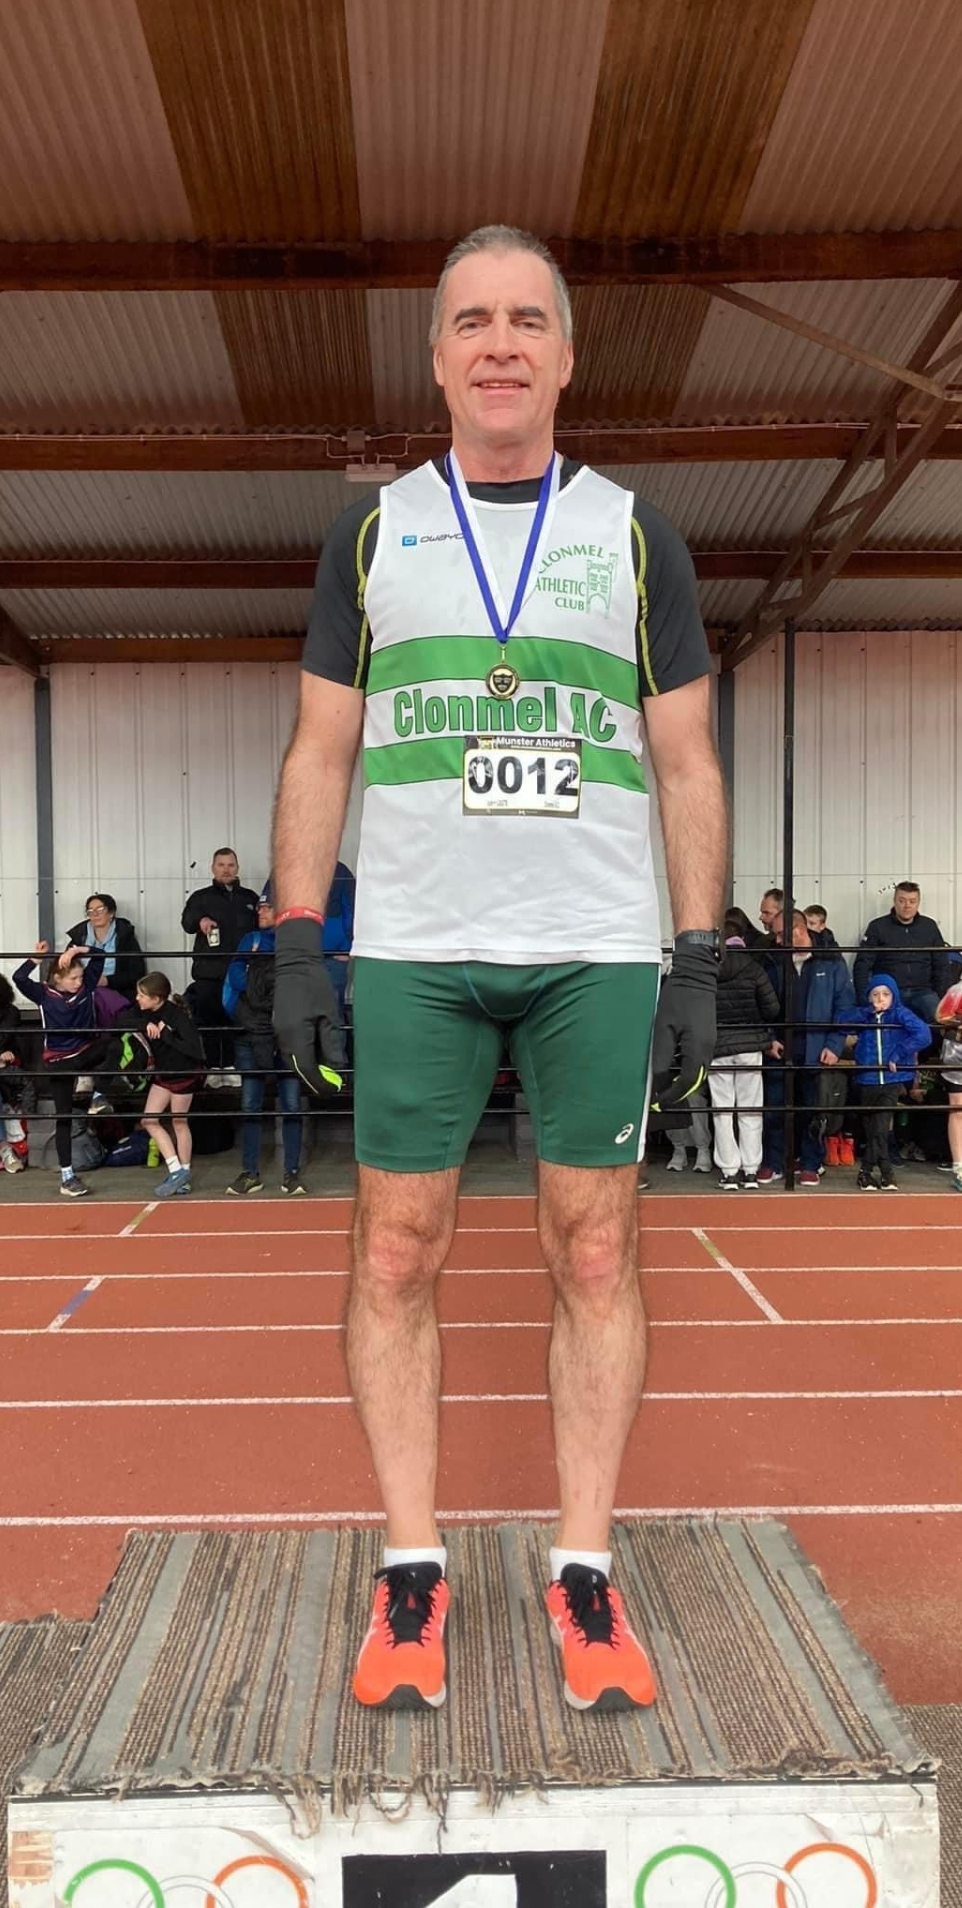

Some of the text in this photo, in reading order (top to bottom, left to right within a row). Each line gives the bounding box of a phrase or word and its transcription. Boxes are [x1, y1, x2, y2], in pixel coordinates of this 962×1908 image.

[554, 597, 584, 611] CLUB
[394, 687, 616, 743] Clonmel AC
[497, 737, 533, 747] Munster
[536, 739, 576, 749] Athletics
[468, 756, 579, 796] 0012
